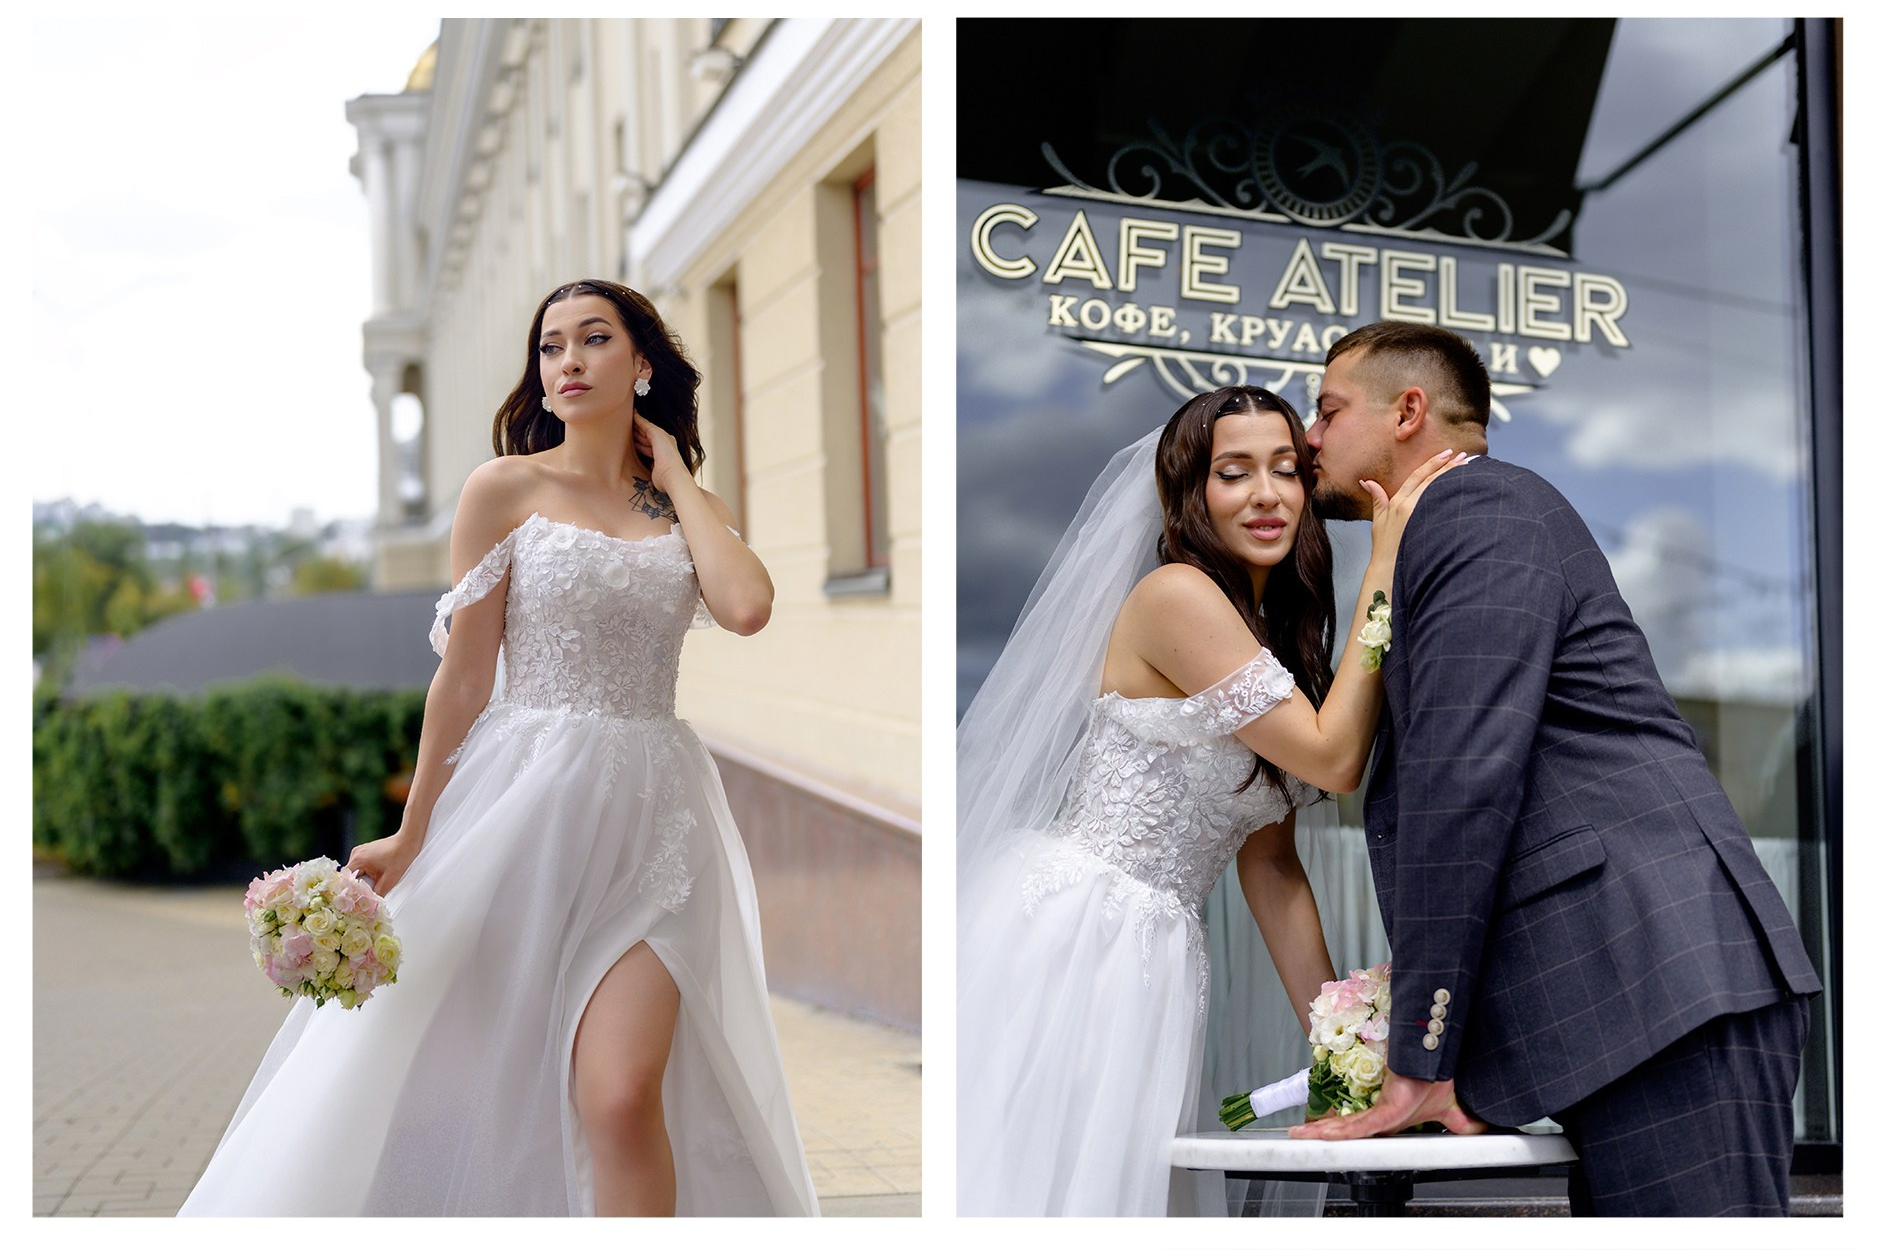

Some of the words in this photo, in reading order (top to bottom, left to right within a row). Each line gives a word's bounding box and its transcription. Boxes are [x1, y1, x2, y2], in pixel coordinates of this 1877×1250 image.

[970, 203, 1242, 304] CAFE
[1268, 237, 1631, 348] ATELIER
[1049, 295, 1192, 344] КОФЕ,
[1209, 312, 1348, 354] КРУАС
